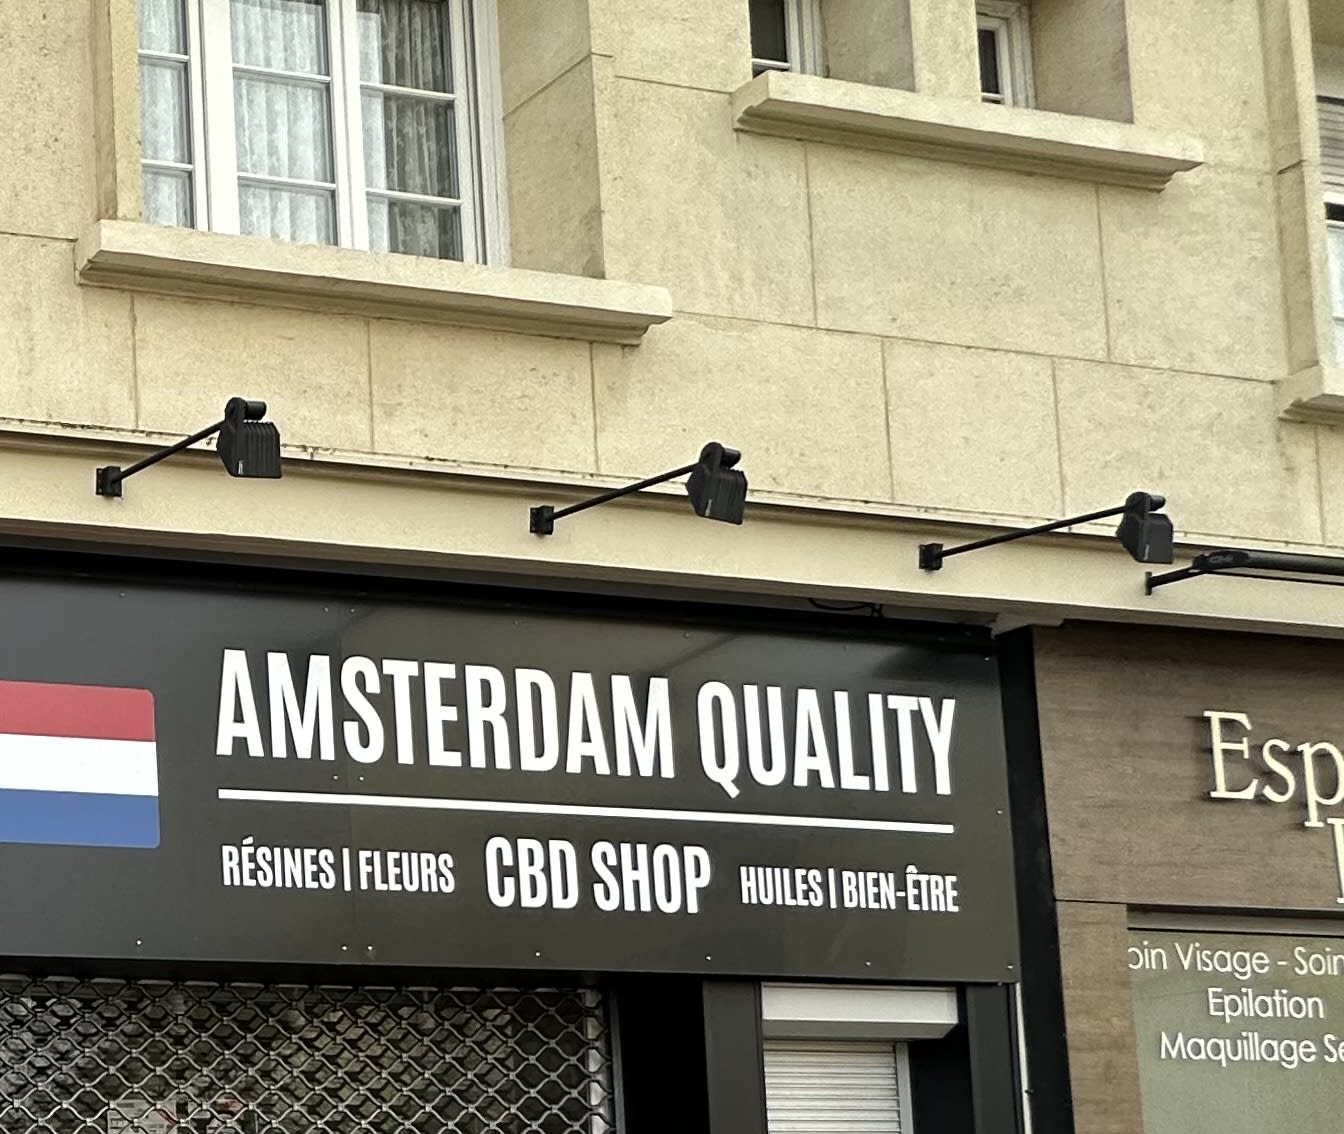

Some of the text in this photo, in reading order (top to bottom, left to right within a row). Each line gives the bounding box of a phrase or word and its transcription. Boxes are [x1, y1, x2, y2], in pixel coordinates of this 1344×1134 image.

[215, 648, 957, 800] AMSTERDAM QUALITY
[1203, 711, 1344, 829] Esp
[221, 836, 336, 890] RÉSINES
[358, 850, 456, 894] FLEURS
[485, 836, 712, 915] CBD SHOP
[740, 865, 823, 905] HUILES
[842, 864, 960, 913] BIEN-ÊTRE
[1174, 942, 1270, 980] Visage
[1207, 987, 1325, 1023] Epilation
[1161, 1031, 1317, 1069] Maquillage
